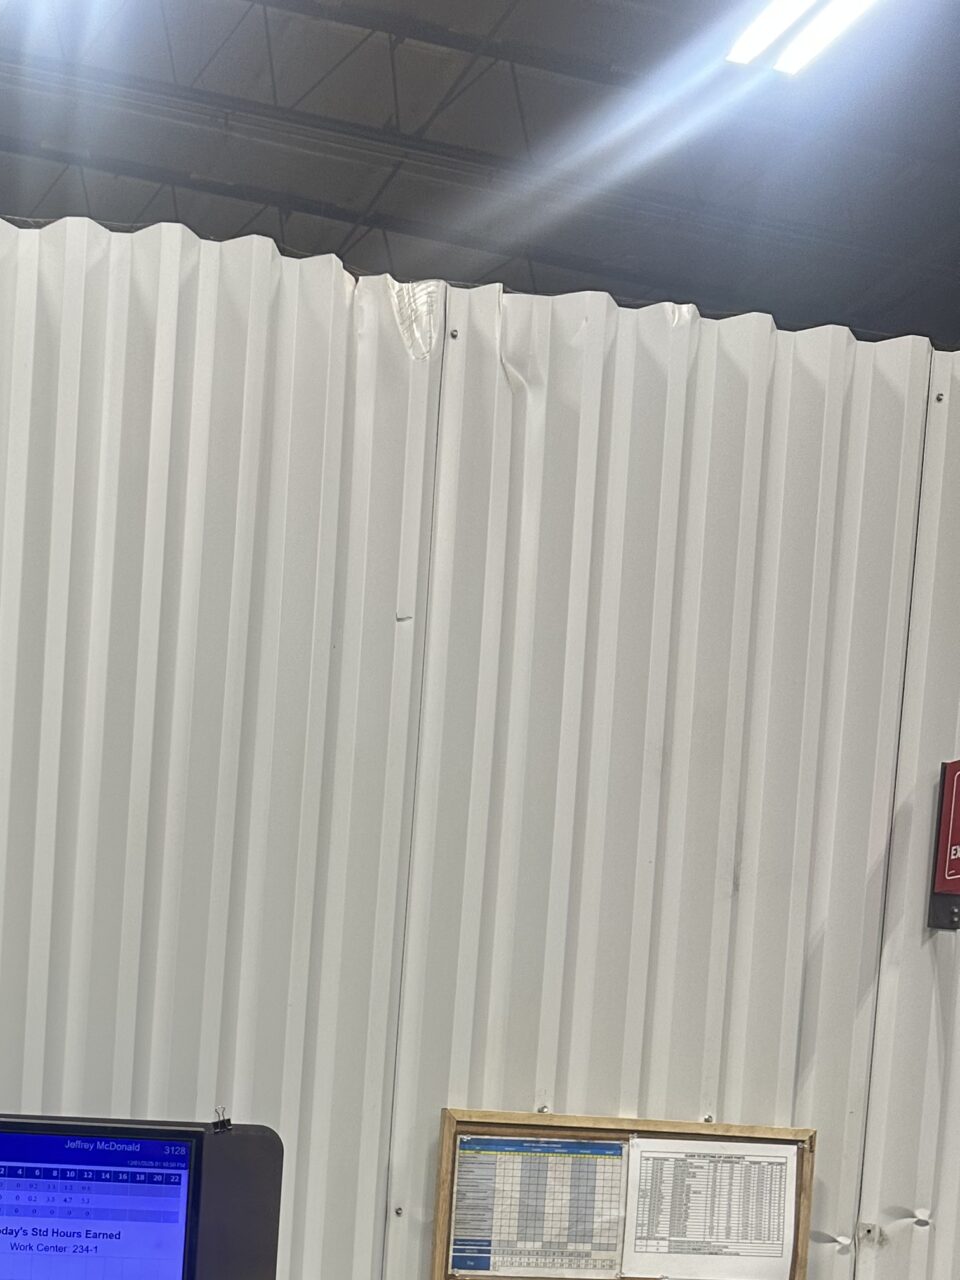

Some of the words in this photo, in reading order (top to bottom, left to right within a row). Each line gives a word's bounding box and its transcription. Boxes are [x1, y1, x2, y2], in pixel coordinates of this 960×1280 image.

[65, 1140, 94, 1151] Jeffrey
[97, 1141, 140, 1152] McDonald
[164, 1146, 186, 1155] 3128
[31, 1228, 49, 1237] Std
[51, 1228, 82, 1239] Hours
[85, 1230, 121, 1240] Earned
[10, 1242, 34, 1252] Work
[72, 1245, 98, 1254] 234-1
